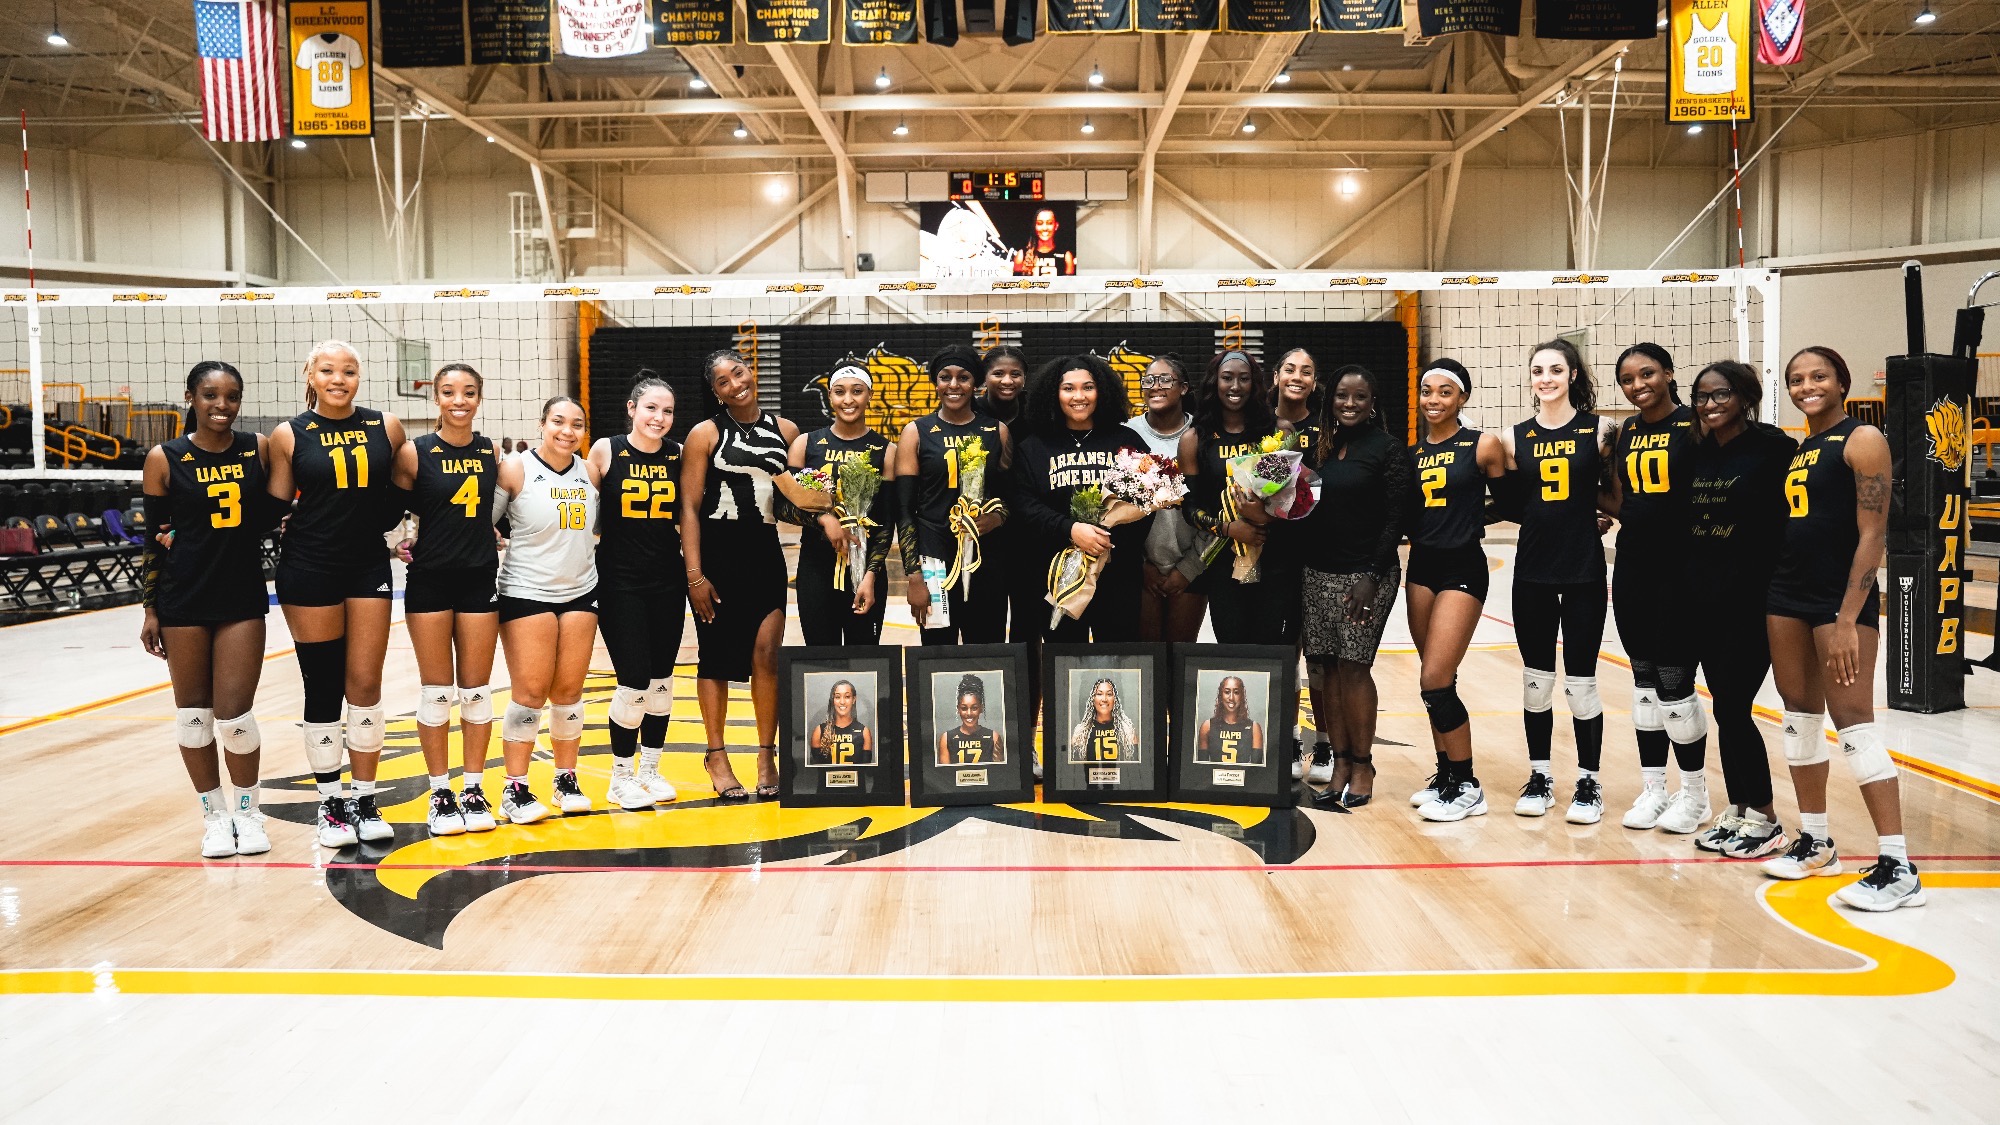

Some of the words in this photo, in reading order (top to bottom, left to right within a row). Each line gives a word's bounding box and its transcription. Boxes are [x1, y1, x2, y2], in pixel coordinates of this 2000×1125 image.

[320, 6, 338, 16] L.C.
[756, 8, 819, 19] CHAMPIONS
[1692, 0, 1729, 9] ALLEN
[294, 16, 364, 26] GREENWOOD
[661, 12, 725, 23] CHAMPIONS
[851, 9, 911, 21] CHAMPONS
[620, 28, 632, 38] UP
[314, 51, 346, 59] GOLDEN
[1698, 45, 1722, 68] 20
[318, 60, 343, 83] 88
[963, 180, 972, 193] 0
[1005, 190, 1009, 200] 1
[1032, 180, 1041, 193] 0
[320, 430, 369, 447] UAPB
[1630, 432, 1670, 450] UAPB
[1219, 444, 1252, 458] UAP
[1533, 440, 1576, 458] UAPB
[329, 445, 369, 489] 11
[442, 459, 484, 474] UAPB
[1417, 451, 1455, 469] UAPB
[1789, 449, 1820, 470] UAPB
[196, 464, 244, 482] UAPB
[629, 464, 668, 479] UAPB
[1050, 470, 1080, 490] PINE
[1540, 457, 1569, 501] 9
[1626, 449, 1670, 493] 10
[1421, 467, 1447, 507] 2
[1724, 476, 1740, 489] of
[450, 475, 480, 518] 4
[551, 487, 587, 500] UAPB
[621, 479, 676, 520] 22
[1785, 469, 1808, 517] 6
[207, 482, 242, 529] 3
[557, 502, 586, 530] 18
[1710, 524, 1737, 538] Bluff
[1937, 494, 1960, 655] UAPB
[1219, 730, 1241, 739] UAPB
[831, 743, 855, 764] 12
[957, 749, 983, 763] 17
[1094, 737, 1118, 760] 15
[1222, 740, 1238, 763] 5
